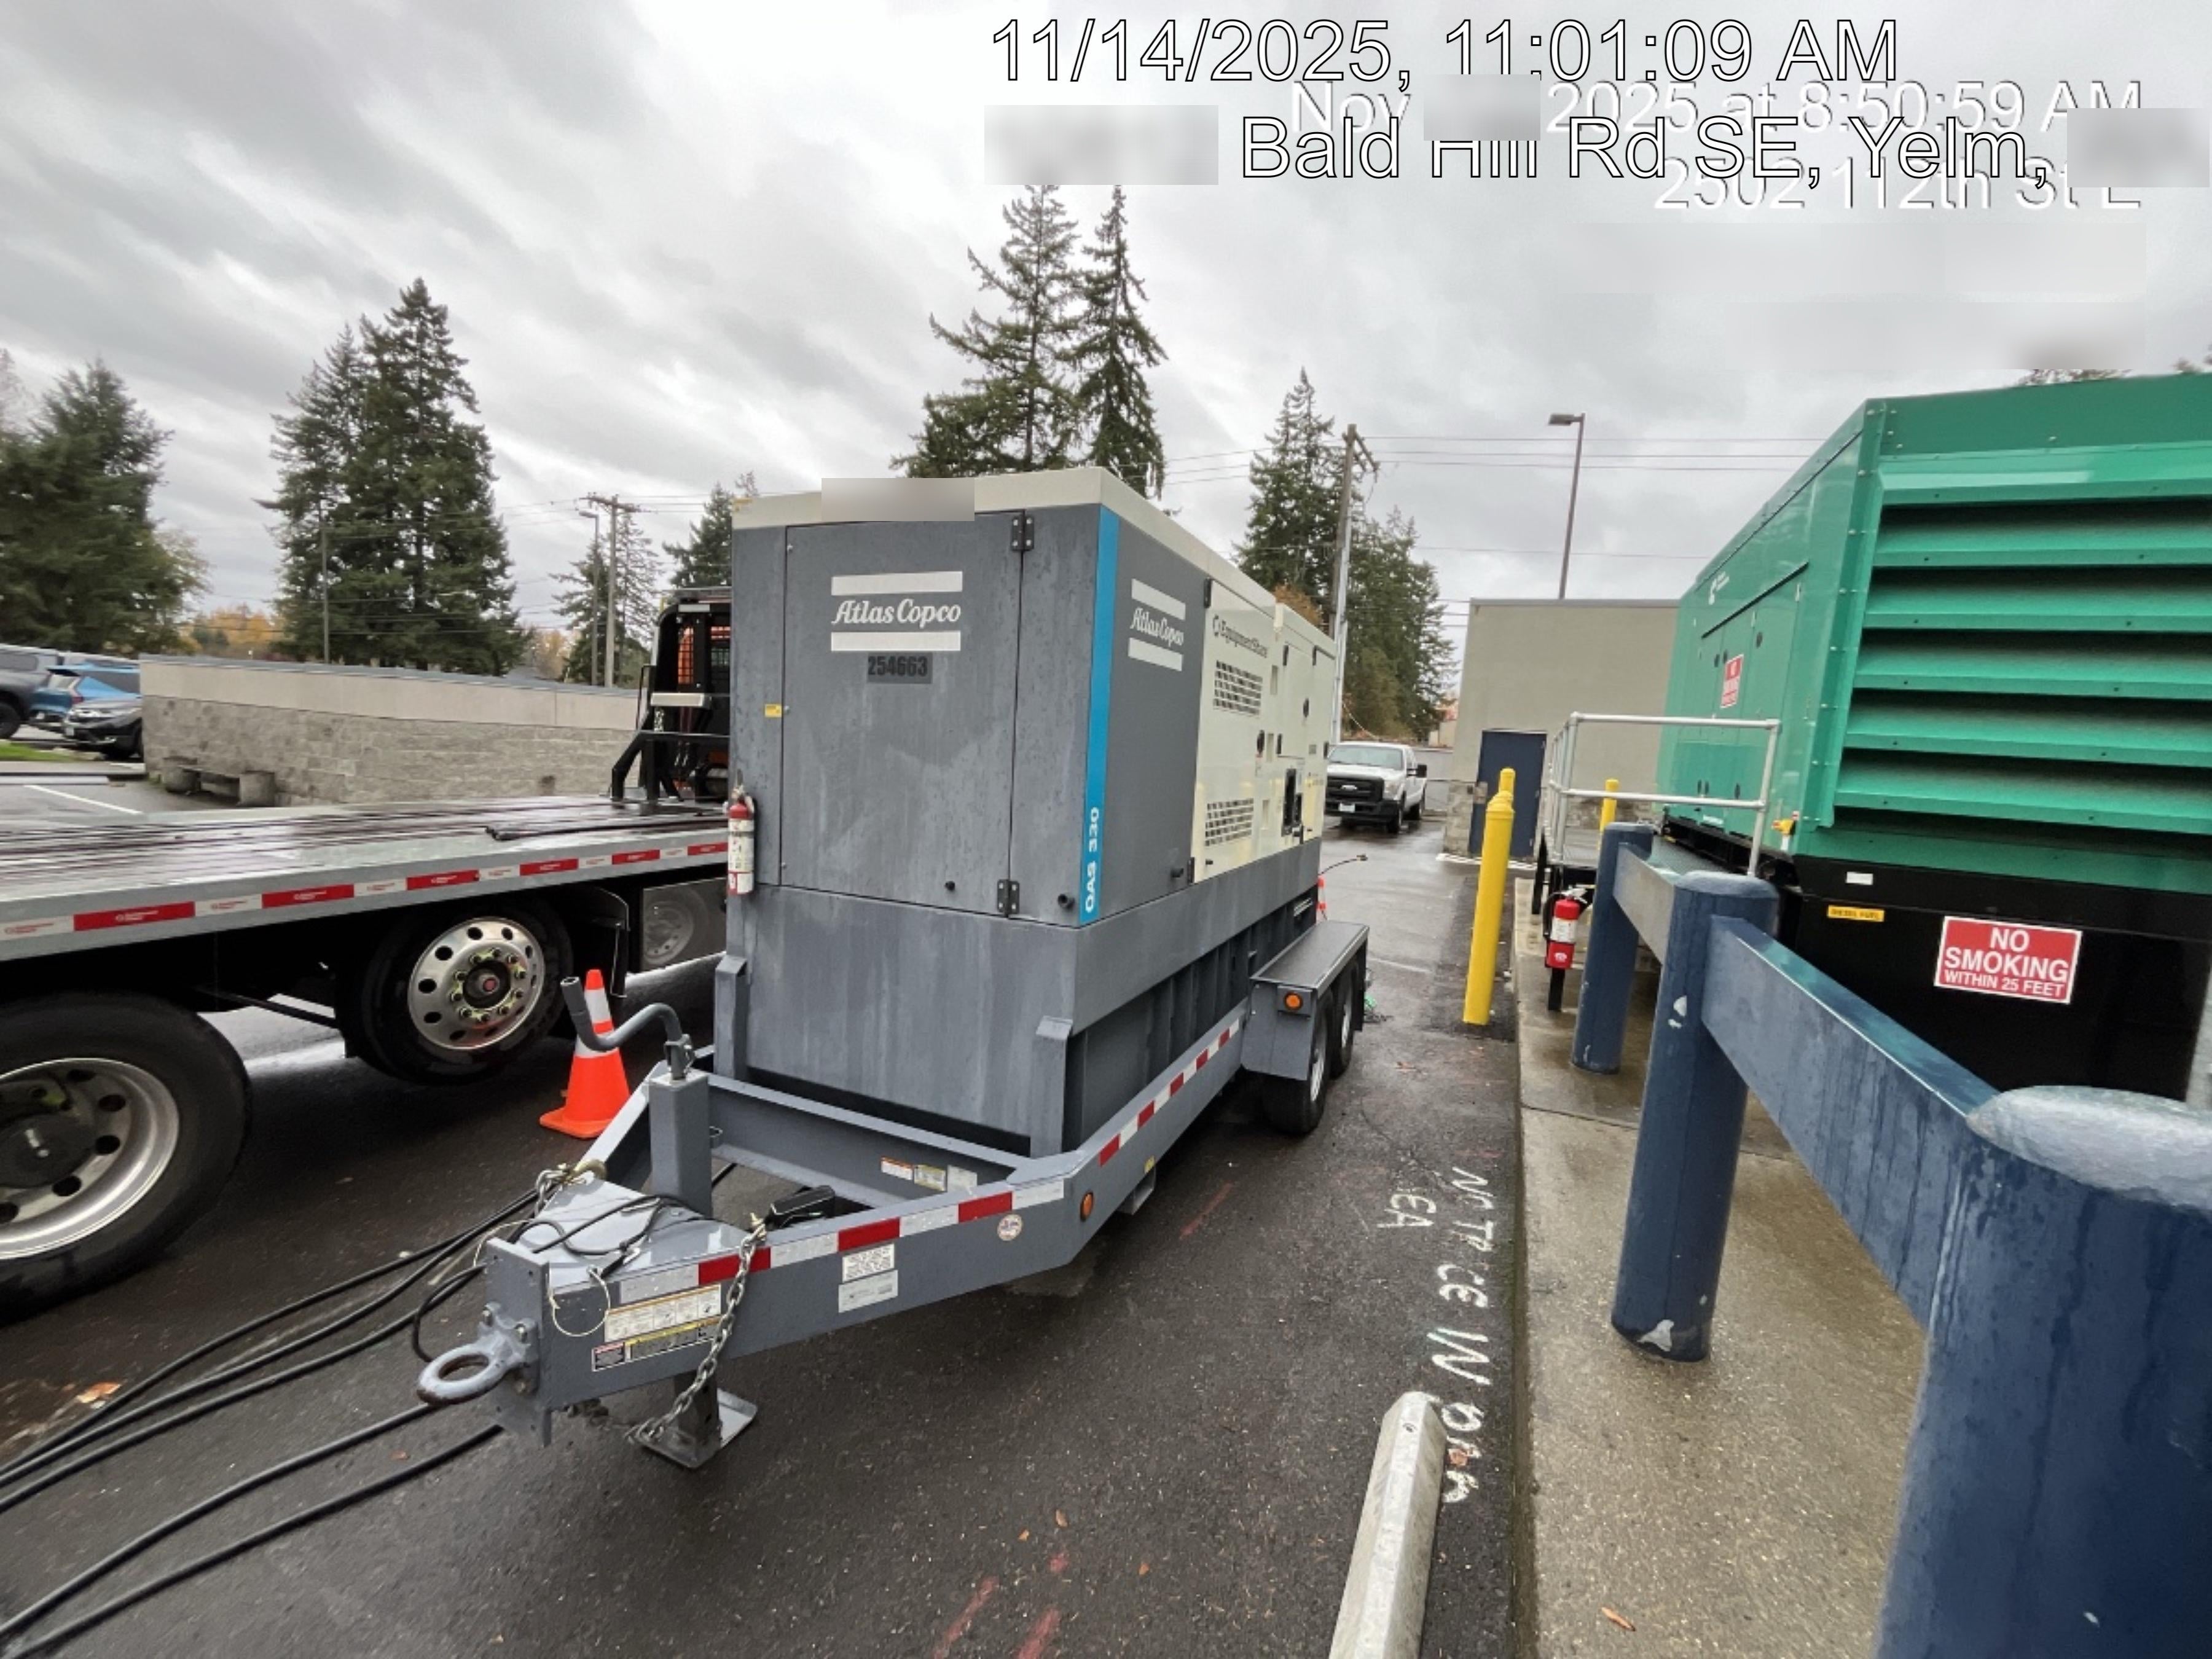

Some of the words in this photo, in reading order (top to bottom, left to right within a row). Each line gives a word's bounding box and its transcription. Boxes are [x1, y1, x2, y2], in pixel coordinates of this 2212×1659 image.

[831, 600, 895, 625] Atlas
[897, 598, 962, 629] Copco
[867, 655, 928, 677] 254663
[1088, 806, 1100, 853] 330
[1989, 927, 2030, 952] NO
[1944, 946, 2069, 983] SMOKING
[1943, 969, 1998, 989] WITHIN
[2001, 978, 2020, 992] 25
[2022, 980, 2066, 997] FEET
